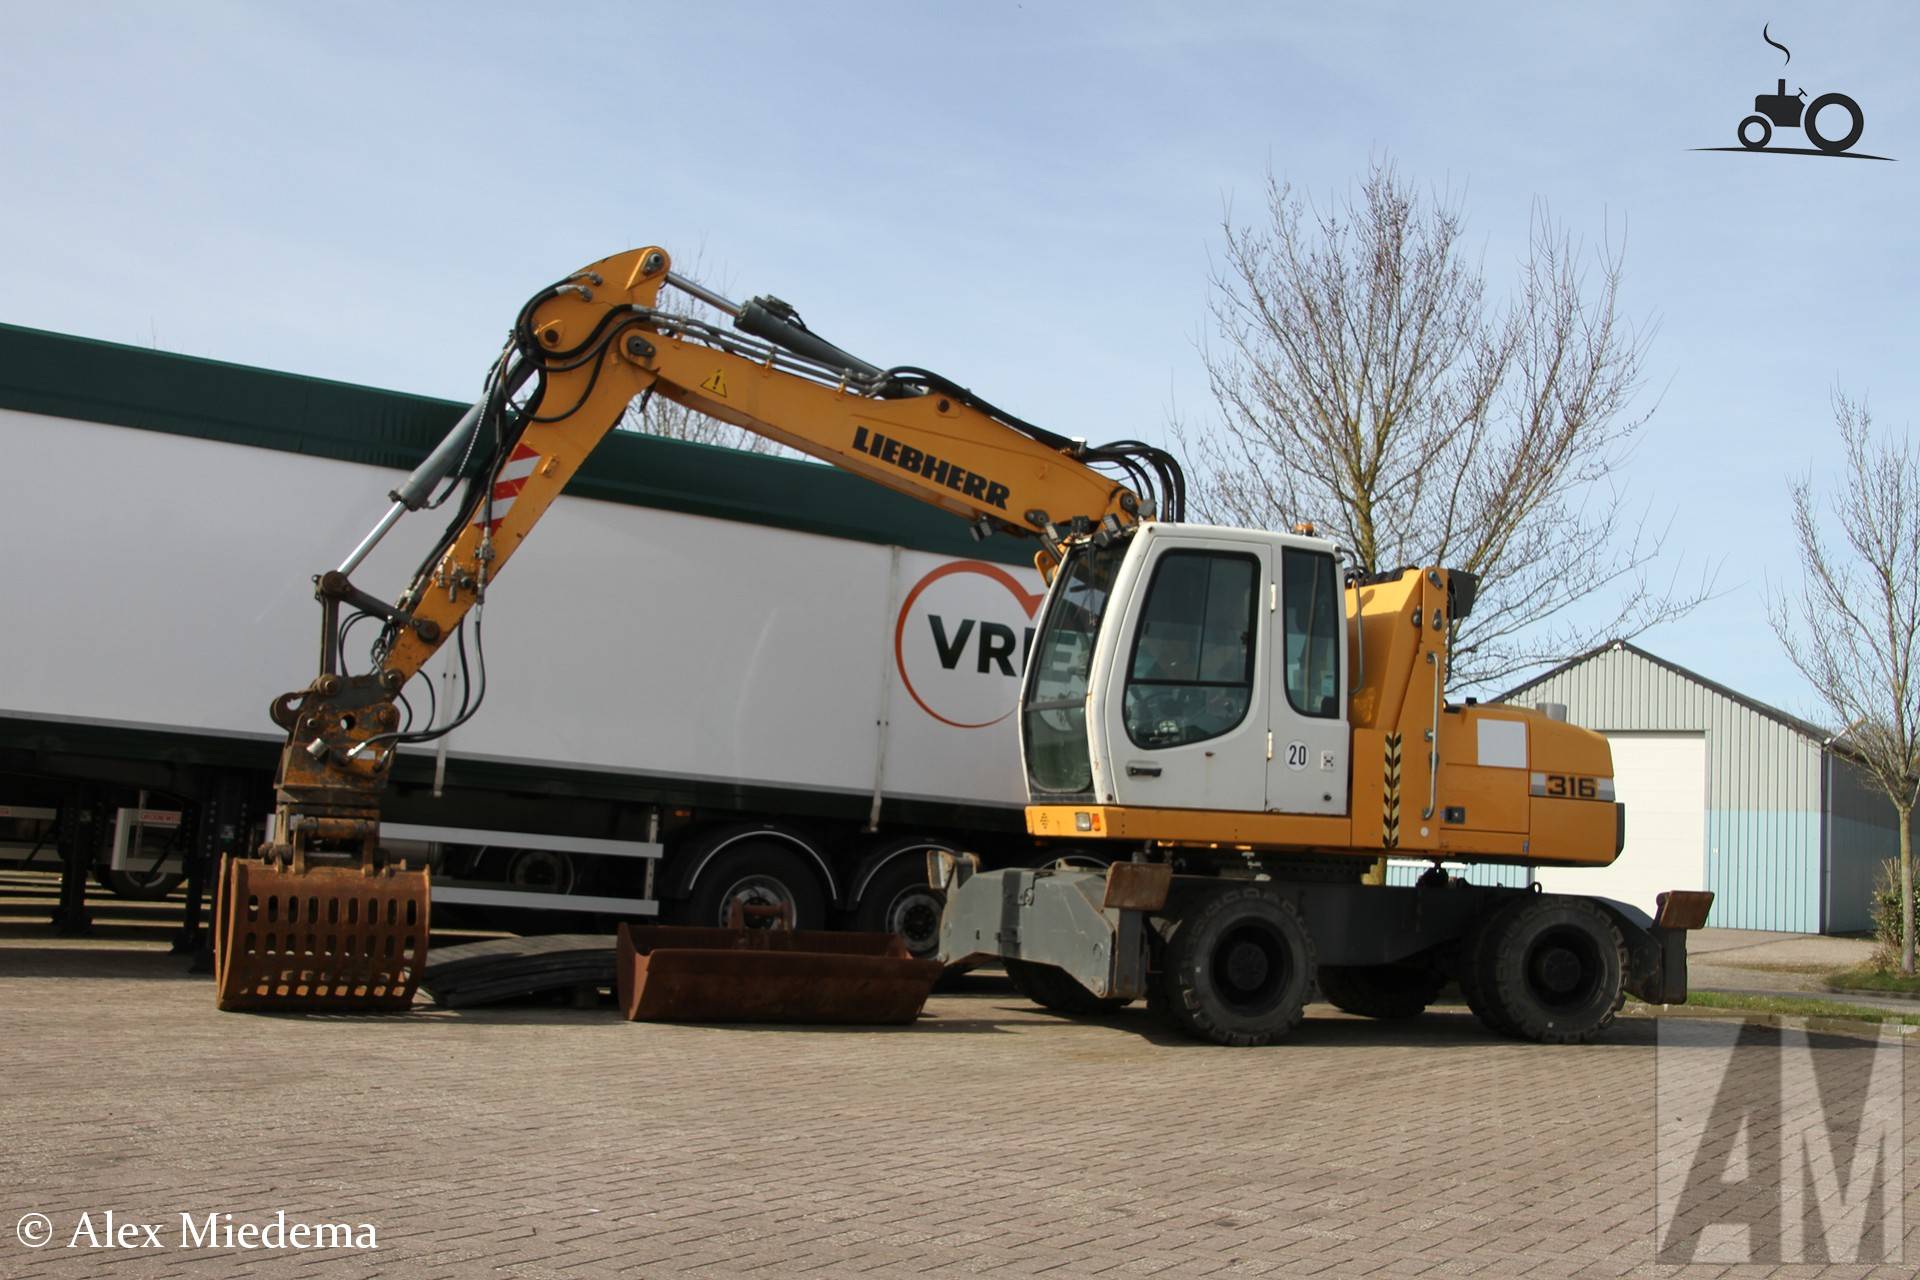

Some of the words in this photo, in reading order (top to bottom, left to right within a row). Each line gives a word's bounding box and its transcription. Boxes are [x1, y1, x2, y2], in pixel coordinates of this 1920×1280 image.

[852, 425, 1010, 510] LIEBHERR
[1288, 744, 1307, 766] 20
[1547, 774, 1597, 798] 316
